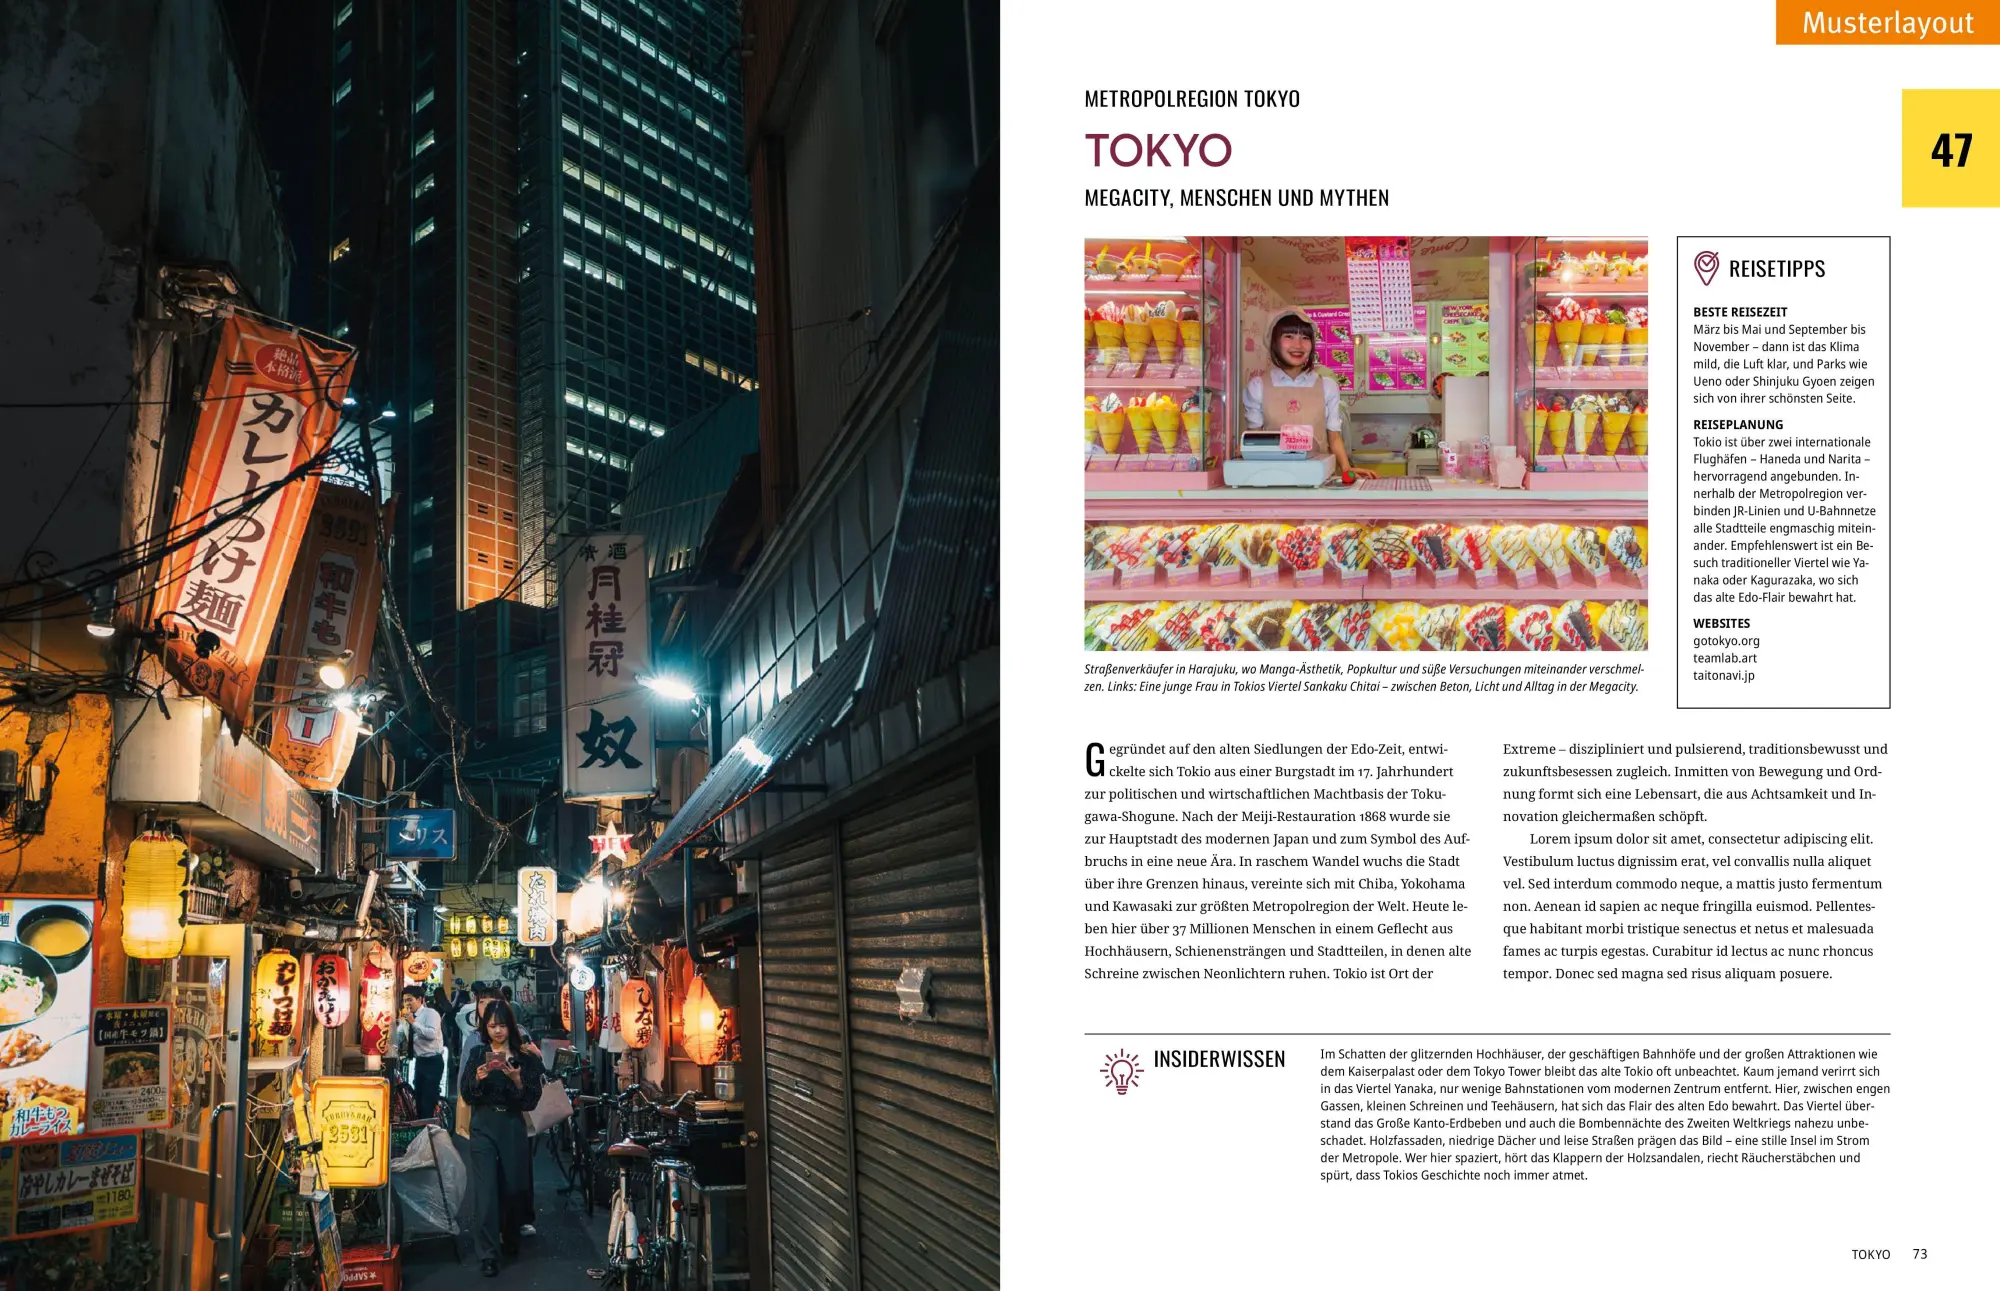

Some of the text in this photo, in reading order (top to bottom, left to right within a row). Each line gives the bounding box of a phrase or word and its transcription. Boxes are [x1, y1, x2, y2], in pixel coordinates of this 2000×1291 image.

[1085, 89, 1300, 108] METROPOLREGION TOKYO
[1085, 133, 1232, 168] TOKYO
[1931, 132, 1973, 168] 47
[1085, 188, 1389, 209] MEGACITY, MENSCHEN UND MYTHEN
[1729, 259, 1826, 278] REISETIPPS
[1693, 306, 1788, 318] BESTE REISEZEIT
[1693, 323, 1866, 338] März bis Mai und September bis
[1693, 341, 1750, 352] November
[1761, 341, 1789, 352] dann
[1792, 341, 1806, 352] ist
[1807, 341, 1827, 352] das
[1830, 341, 1860, 352] Klima
[1693, 419, 1784, 430] REISEPLANUNG
[584, 565, 628, 678] 月桂冠
[1692, 618, 1751, 629] WEBSITES
[1693, 635, 1760, 649] gotokyo.org
[1693, 652, 1757, 664] teamlab.art
[1083, 661, 1645, 677] Straßenverkäufer in Harajuku, wo Manga-Ästhetik, Popkultur und süße Versuchungen miteinander verschmel-
[1693, 670, 1755, 684] taitonavi.jp
[1083, 683, 1104, 692] zen.
[1107, 680, 1137, 692] Links:
[1139, 681, 1161, 692] Eine
[1161, 681, 1193, 695] junge
[1195, 681, 1219, 692] Frau
[1220, 681, 1231, 691] in
[1233, 680, 1266, 692] Tokios
[1268, 680, 1302, 692] Viertel
[1303, 680, 1348, 692] Sankaku
[1350, 680, 1381, 692] Chitai
[1390, 680, 1437, 692] zwischen
[1439, 681, 1472, 693] Beton,
[1475, 680, 1501, 692] Licht
[1501, 680, 1523, 692] und
[1523, 680, 1555, 695] Alltag
[1557, 681, 1567, 692] in
[1569, 680, 1588, 692] der
[1589, 681, 1638, 695] Megacity.
[575, 708, 643, 769] 奴
[1503, 743, 1556, 755] Extreme
[1569, 743, 1645, 758] diszipliniert
[1647, 743, 1673, 755] und
[1675, 743, 1746, 758] pulsierend,
[1748, 743, 1861, 755] traditionsbewusst
[1863, 743, 1888, 755] und
[1503, 765, 1882, 780] zukunftsbesessen zugleich. Inmitten von Bewegung und Ord-
[1084, 788, 1446, 803] zur politischen und wirtschaftlichen Machtbasis der Toku-
[1084, 810, 1451, 825] gawa-Shogune. Nach der Meiji-Restauration 1868 wurde sie
[528, 870, 548, 942] たれ焼肉
[1154, 1049, 1285, 1068] INSIDERWISSEN
[1320, 1048, 1878, 1063] Im Schatten der glitzernden Hochhäuser, der geschäftigen Bahnhöfe und der großen Attraktionen wie
[15, 1107, 68, 1124] 和牛もつ
[9, 1120, 72, 1137] カレーライス
[1851, 1249, 1891, 1260] TOKYO
[1912, 1248, 1928, 1260] 73
